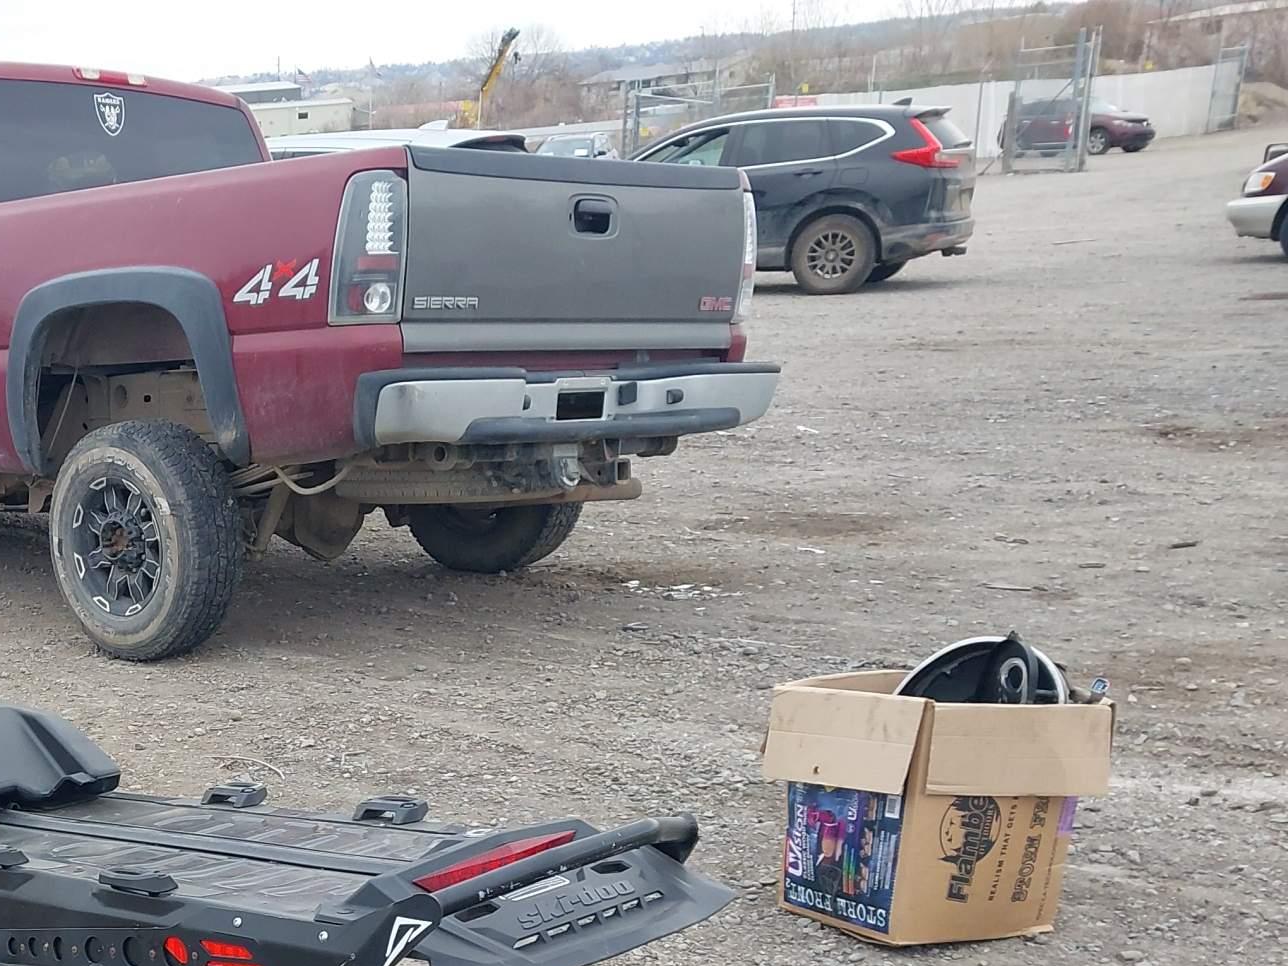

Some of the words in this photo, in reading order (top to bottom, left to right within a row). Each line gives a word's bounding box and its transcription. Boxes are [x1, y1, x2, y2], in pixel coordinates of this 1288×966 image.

[413, 296, 479, 310] SIERRA
[699, 296, 732, 311] GMC
[1000, 832, 1011, 856] THAT
